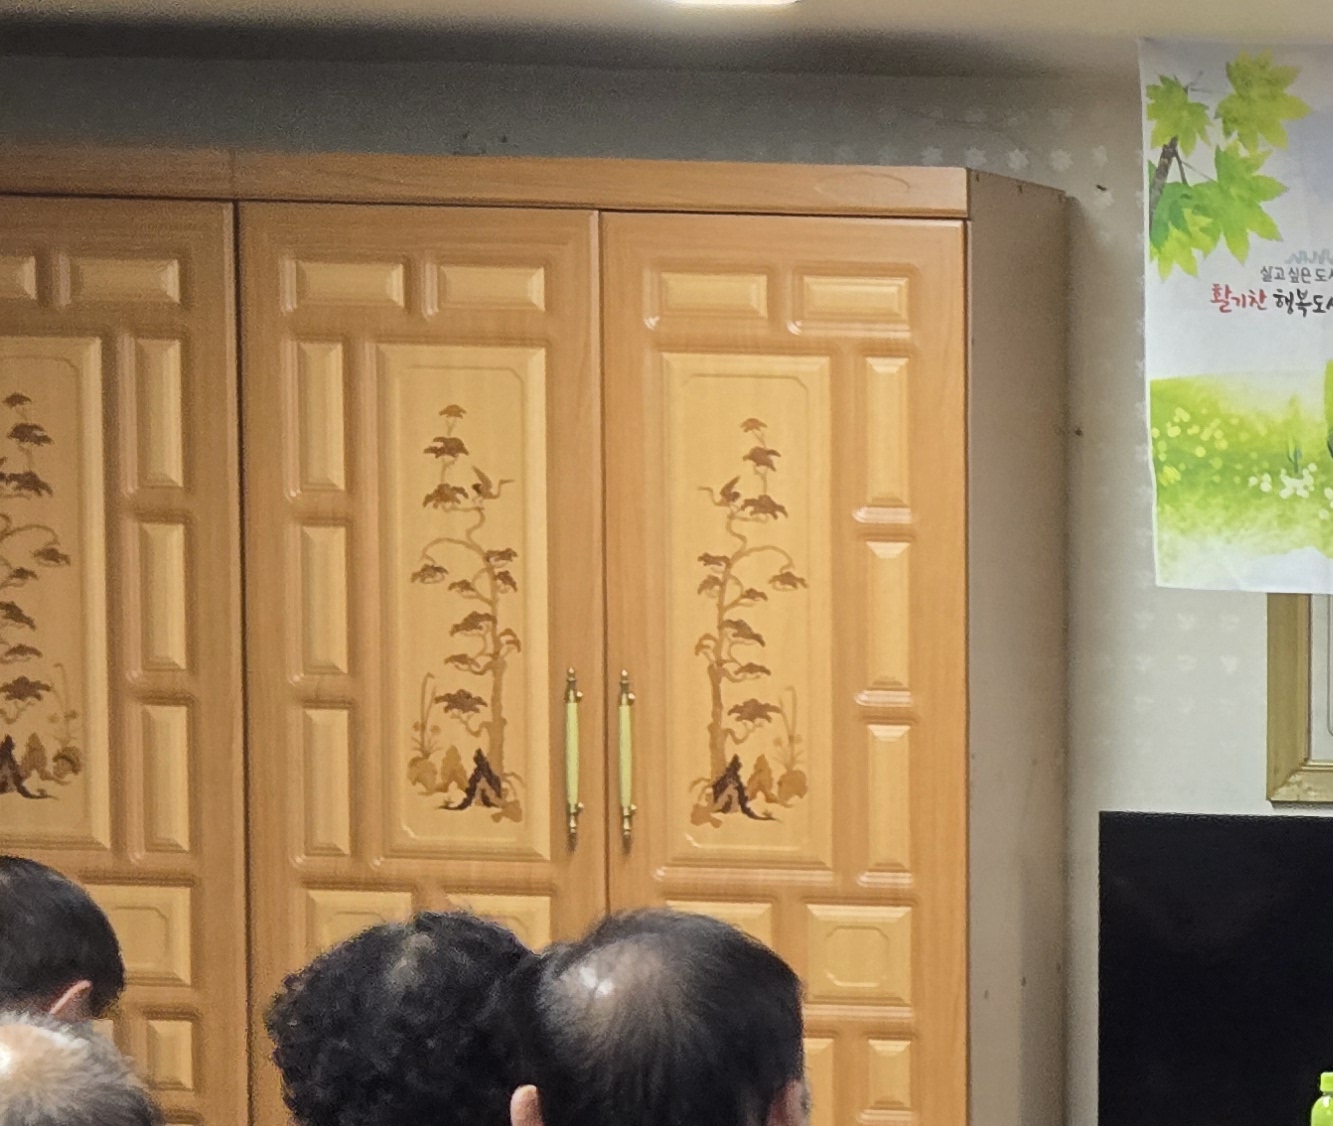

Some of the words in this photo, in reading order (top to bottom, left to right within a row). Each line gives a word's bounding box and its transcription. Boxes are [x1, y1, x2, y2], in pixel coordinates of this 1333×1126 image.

[1260, 266, 1285, 282] 살고
[1288, 267, 1312, 283] 싶은
[1210, 284, 1267, 313] 활기찬
